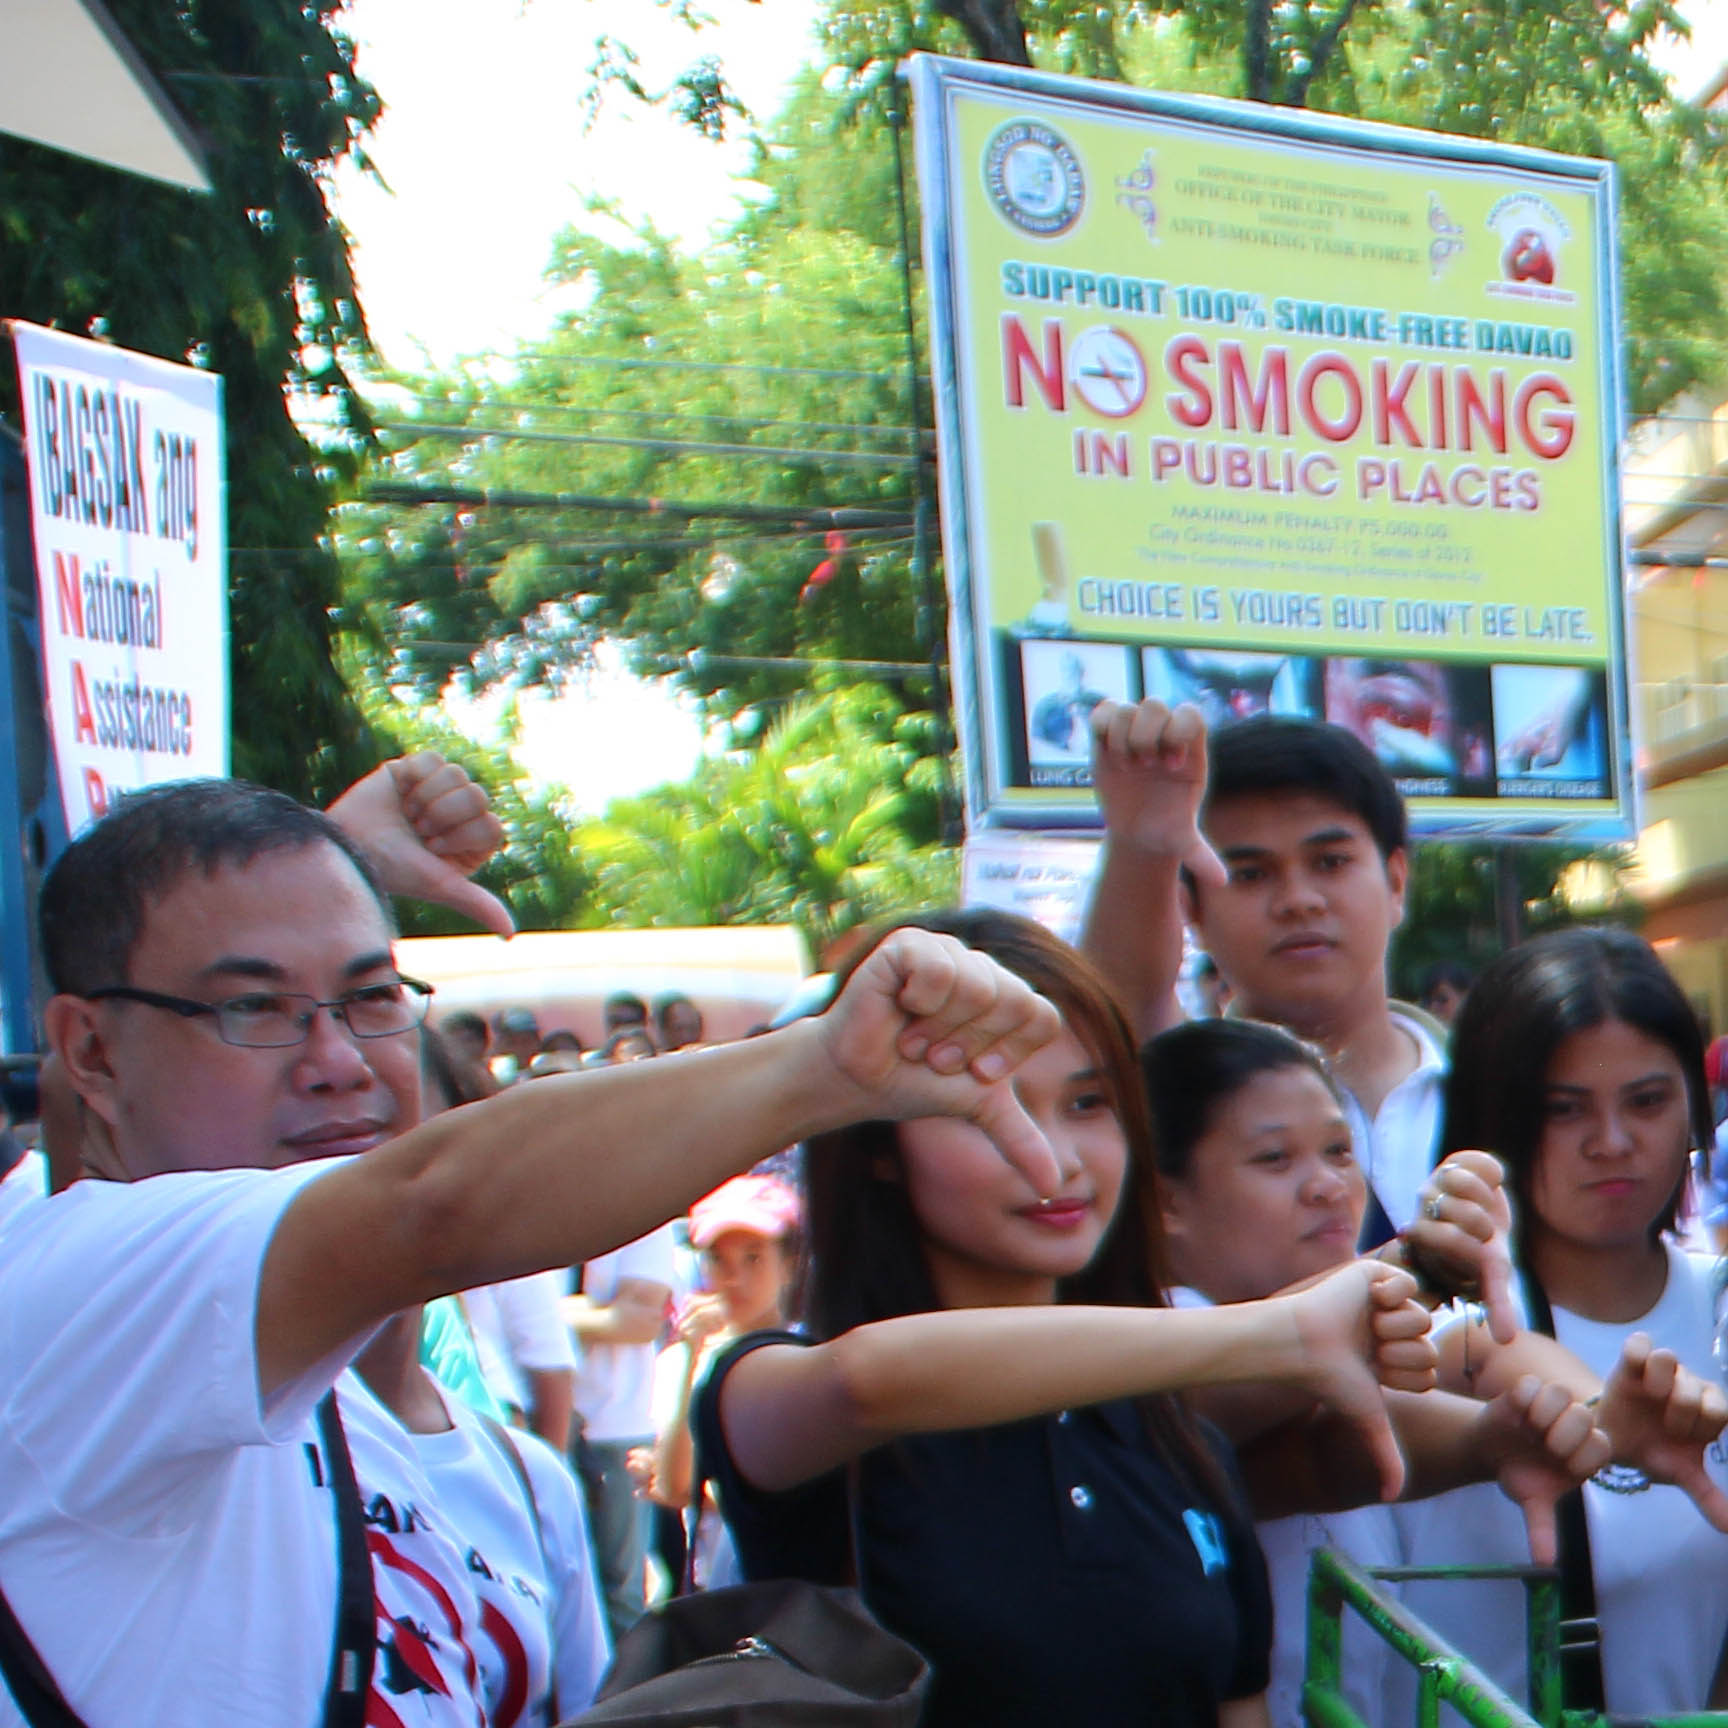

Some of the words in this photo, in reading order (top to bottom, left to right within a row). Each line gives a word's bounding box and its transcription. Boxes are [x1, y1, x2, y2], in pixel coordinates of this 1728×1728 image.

[1002, 260, 1168, 314] SUPPORT
[1176, 286, 1266, 327] 100%
[1274, 299, 1471, 350] SMOKE-FREE
[1477, 322, 1574, 361] DAVAO
[1164, 333, 1576, 461] SMOKING
[35, 372, 149, 535] BAGSAK
[154, 427, 199, 562] ang
[1075, 430, 1130, 476] IN
[1152, 436, 1339, 496] PUBLIC
[1357, 462, 1541, 512] PLACES
[1171, 505, 1267, 526] MAXIMUM
[1274, 512, 1352, 533] PENALTY
[53, 551, 164, 650] National
[1078, 577, 1183, 618] CHOICE
[1192, 587, 1221, 621] IS
[1230, 590, 1323, 629] YOURS
[1333, 596, 1386, 634] BUT
[1394, 600, 1476, 638] DON'T
[1483, 604, 1518, 640] BE
[1525, 607, 1595, 644] LATE.
[71, 660, 192, 757] Assistance
